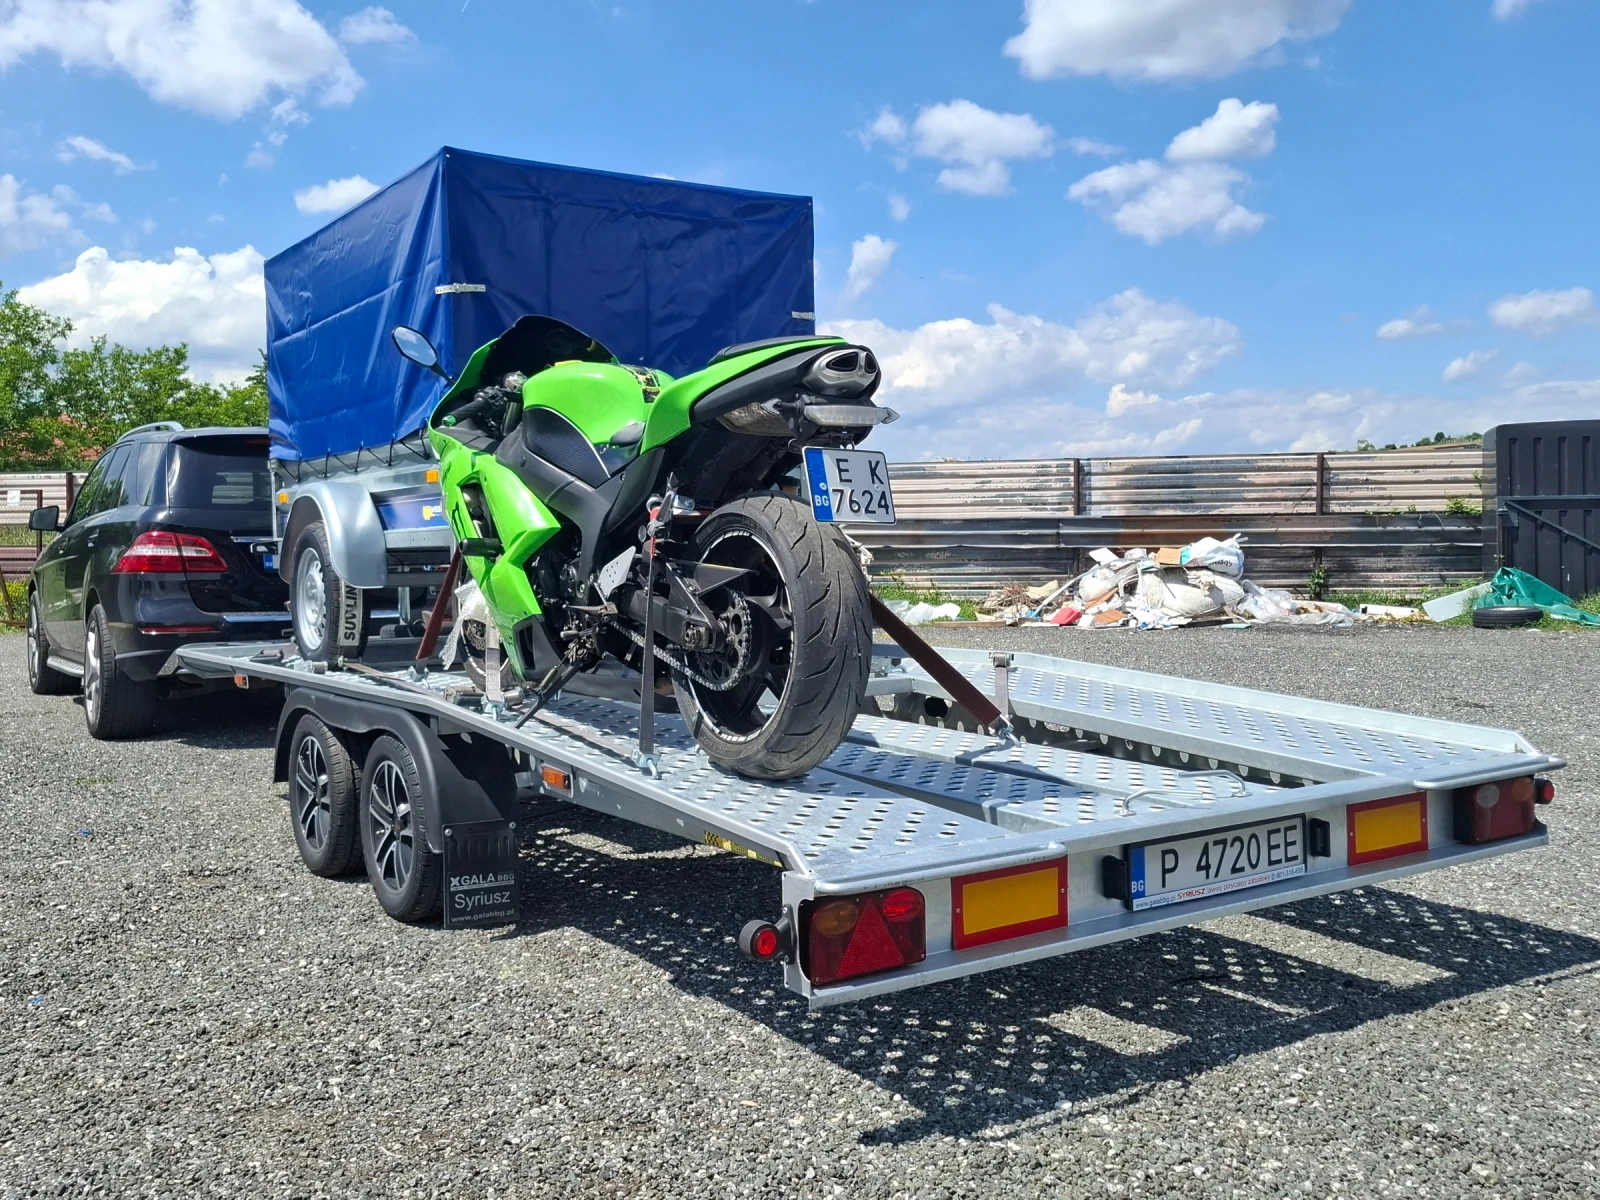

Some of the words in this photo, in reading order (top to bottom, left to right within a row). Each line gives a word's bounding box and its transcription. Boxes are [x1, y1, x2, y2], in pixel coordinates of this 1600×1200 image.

[835, 457, 853, 483] E
[868, 459, 885, 485] K
[814, 494, 829, 507] BG
[830, 488, 890, 515] 7624
[1161, 848, 1179, 889] P
[497, 873, 515, 881] BBG
[1131, 878, 1144, 894] BG
[1177, 887, 1206, 900] SYRIUSZ
[454, 892, 510, 911] Syriusz
[451, 908, 515, 922] www.galabbg.pl
